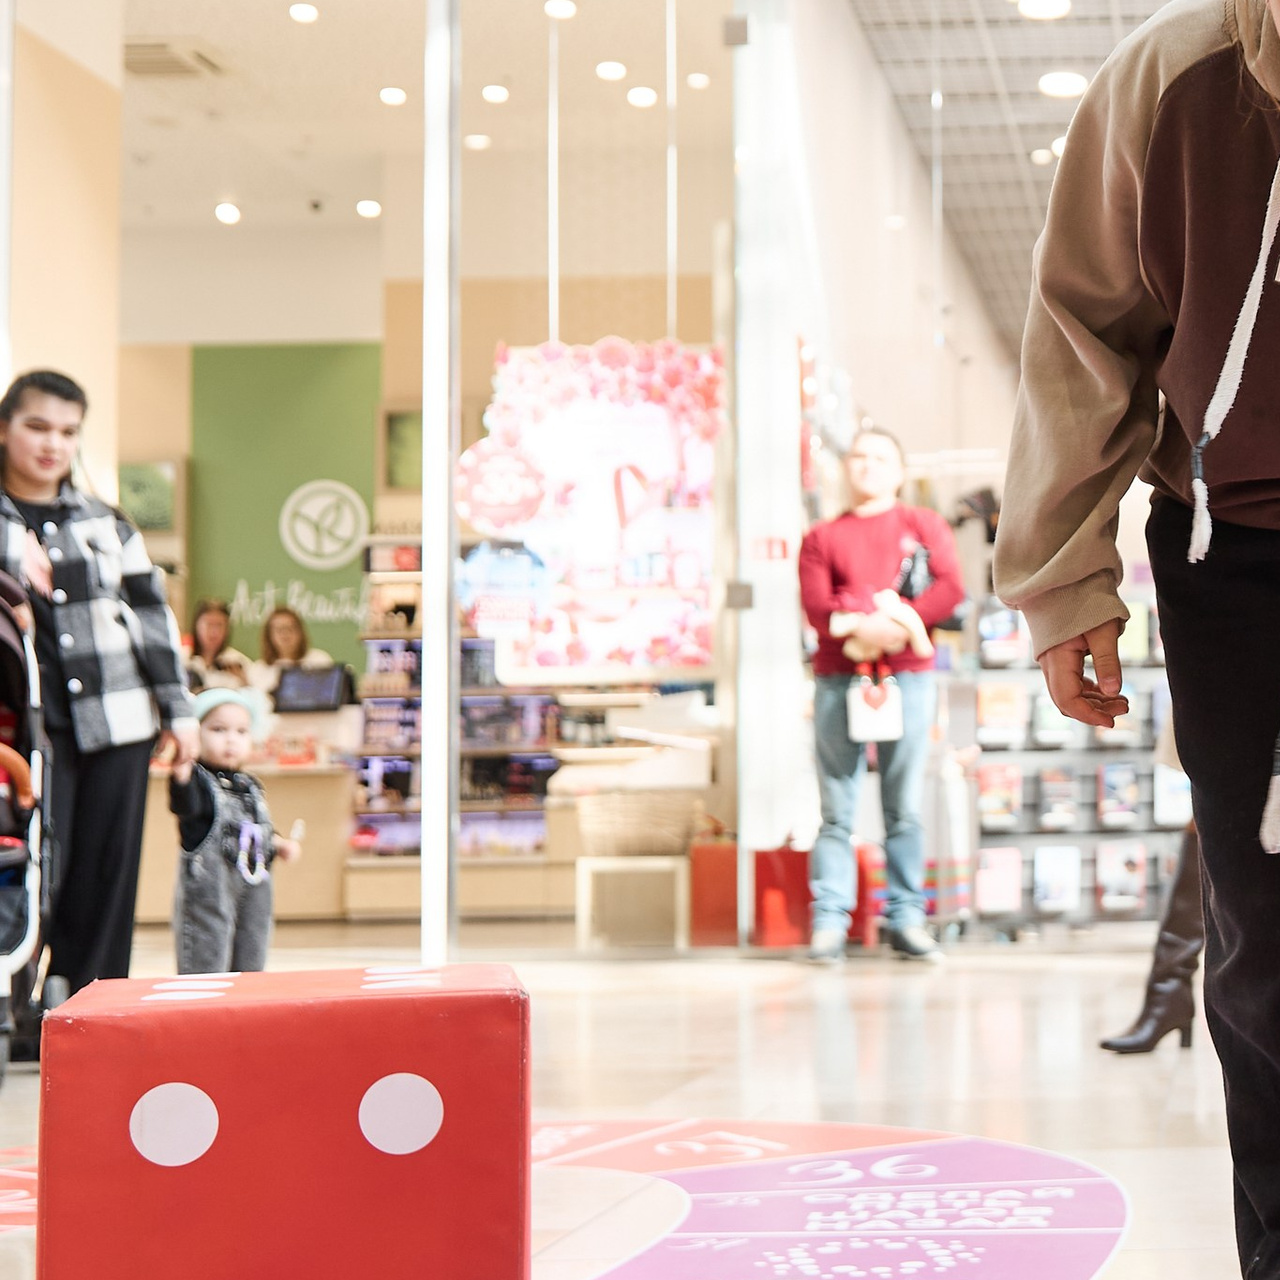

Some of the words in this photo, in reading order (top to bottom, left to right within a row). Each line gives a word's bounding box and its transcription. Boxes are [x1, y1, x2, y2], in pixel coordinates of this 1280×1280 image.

[779, 1154, 939, 1186] 36
[803, 1186, 1075, 1205] СДЕЛАЙ
[850, 1197, 1024, 1211] ПЯТЬ
[806, 1205, 1054, 1221] ШАГОВ
[804, 1216, 1050, 1231] НАЗАД
